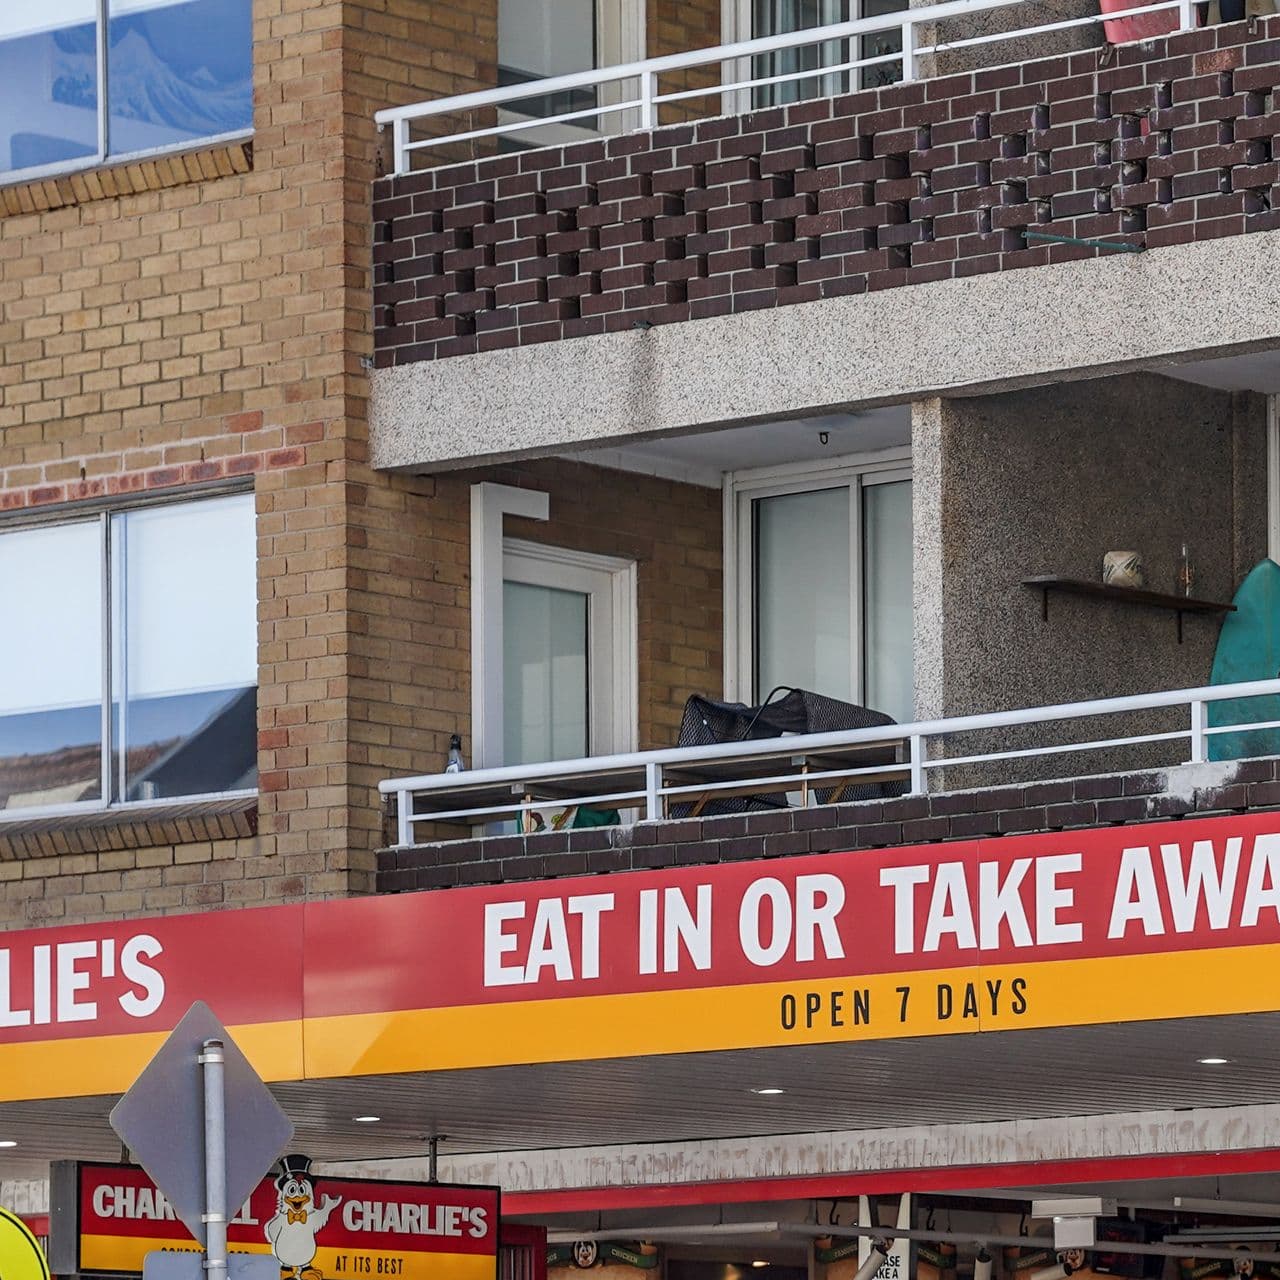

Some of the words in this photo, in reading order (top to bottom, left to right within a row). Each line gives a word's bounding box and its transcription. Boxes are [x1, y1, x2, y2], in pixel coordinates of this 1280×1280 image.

[484, 893, 614, 987] EAT
[639, 885, 713, 975] IN
[739, 873, 846, 967] OR
[880, 853, 1083, 955] TAKE
[781, 989, 871, 1030] OPEN
[895, 987, 910, 1023] 7
[938, 978, 1029, 1021] DAYS
[342, 1199, 488, 1239] CHARLIE'S
[335, 1255, 347, 1271] AT
[353, 1256, 372, 1273] ITS
[377, 1257, 404, 1275] BEST
[874, 1268, 891, 1279] AKE
[892, 1269, 899, 1279] A
